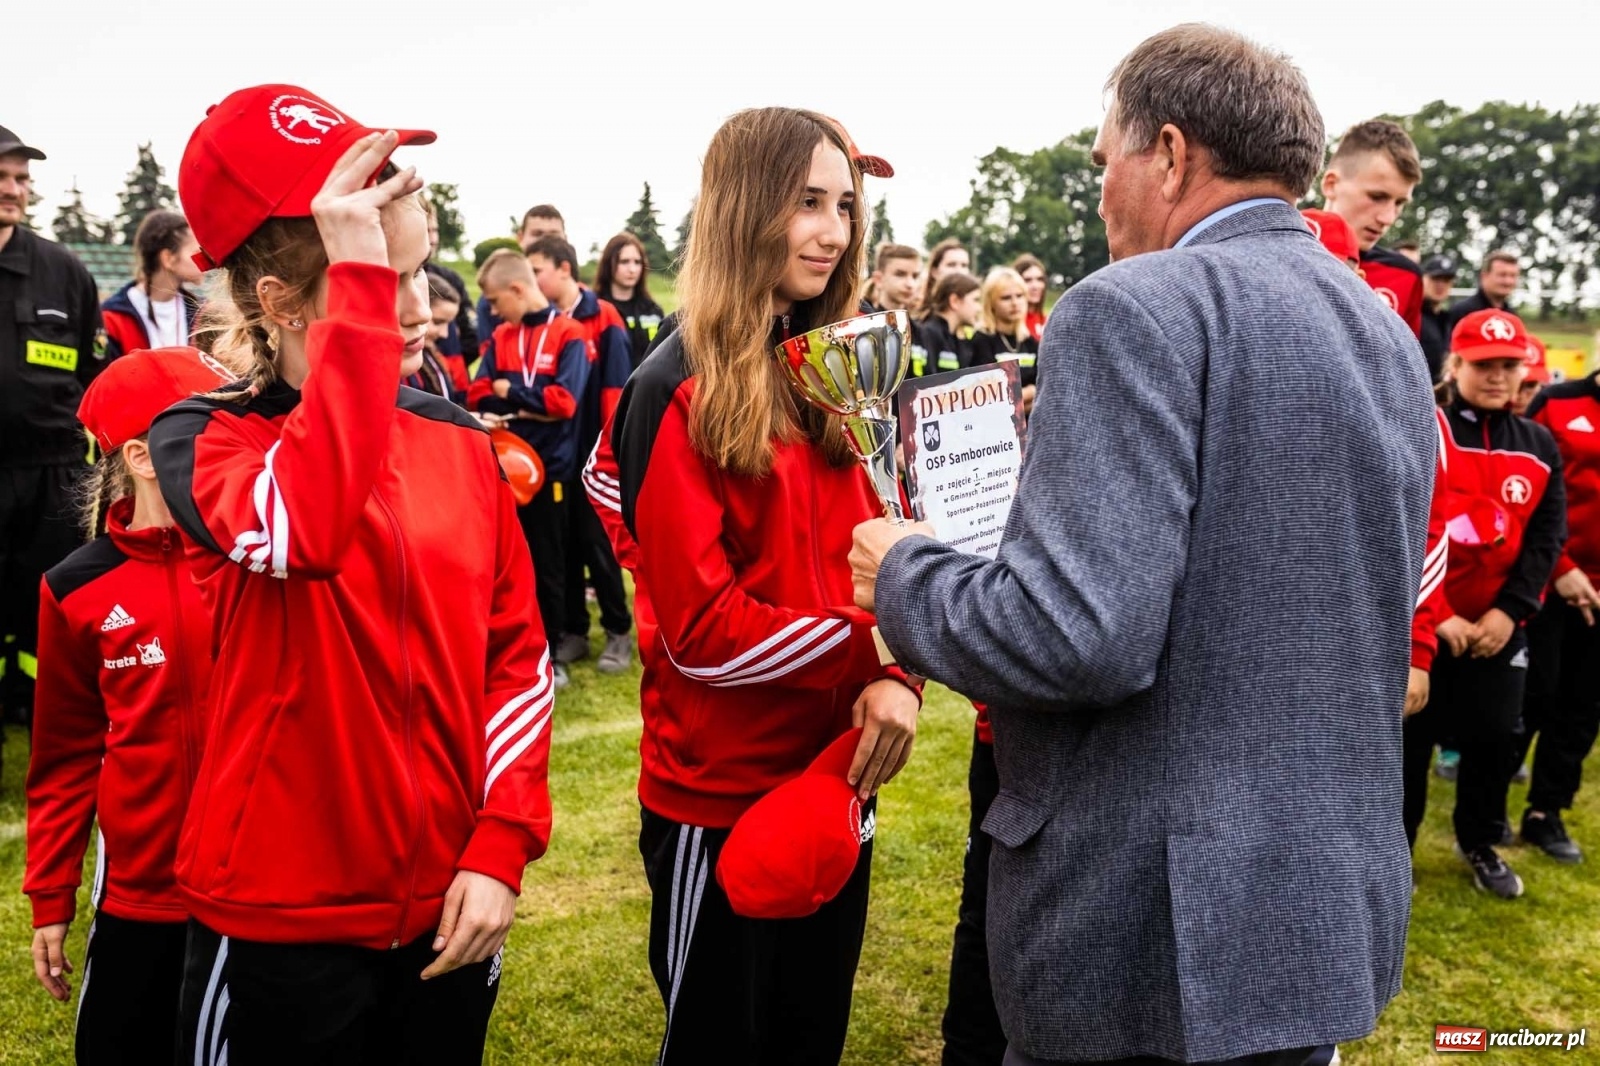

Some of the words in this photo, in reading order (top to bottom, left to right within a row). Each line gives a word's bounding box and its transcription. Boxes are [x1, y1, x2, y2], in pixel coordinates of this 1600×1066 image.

[920, 382, 1004, 419] DYPLOM
[964, 423, 973, 431] dla
[926, 454, 946, 471] OSP
[948, 440, 1014, 465] Samborowice
[950, 488, 979, 503] Gminnych
[977, 513, 996, 526] grupie
[101, 617, 135, 631] adidas
